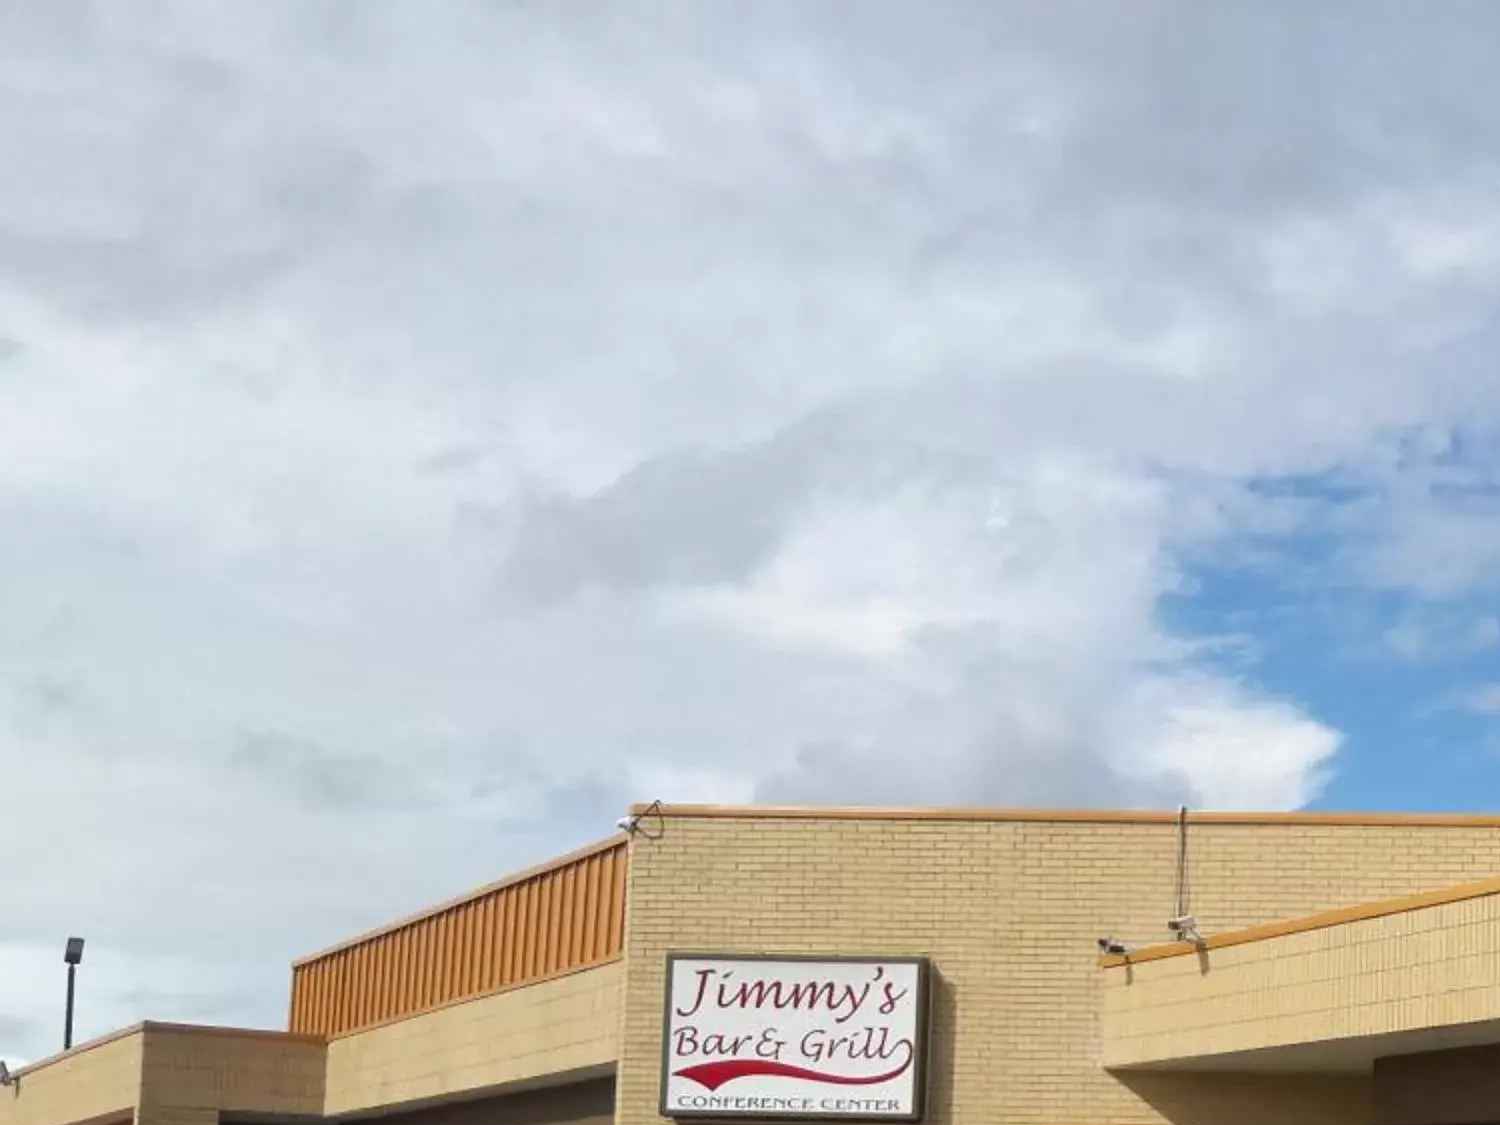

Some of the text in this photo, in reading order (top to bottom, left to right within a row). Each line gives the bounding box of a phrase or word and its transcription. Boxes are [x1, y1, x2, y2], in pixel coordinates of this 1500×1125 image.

[677, 966, 907, 1023] Jimmy's
[800, 1028, 903, 1062] Grill
[677, 1095, 902, 1111] CONFERENCE CENTER
